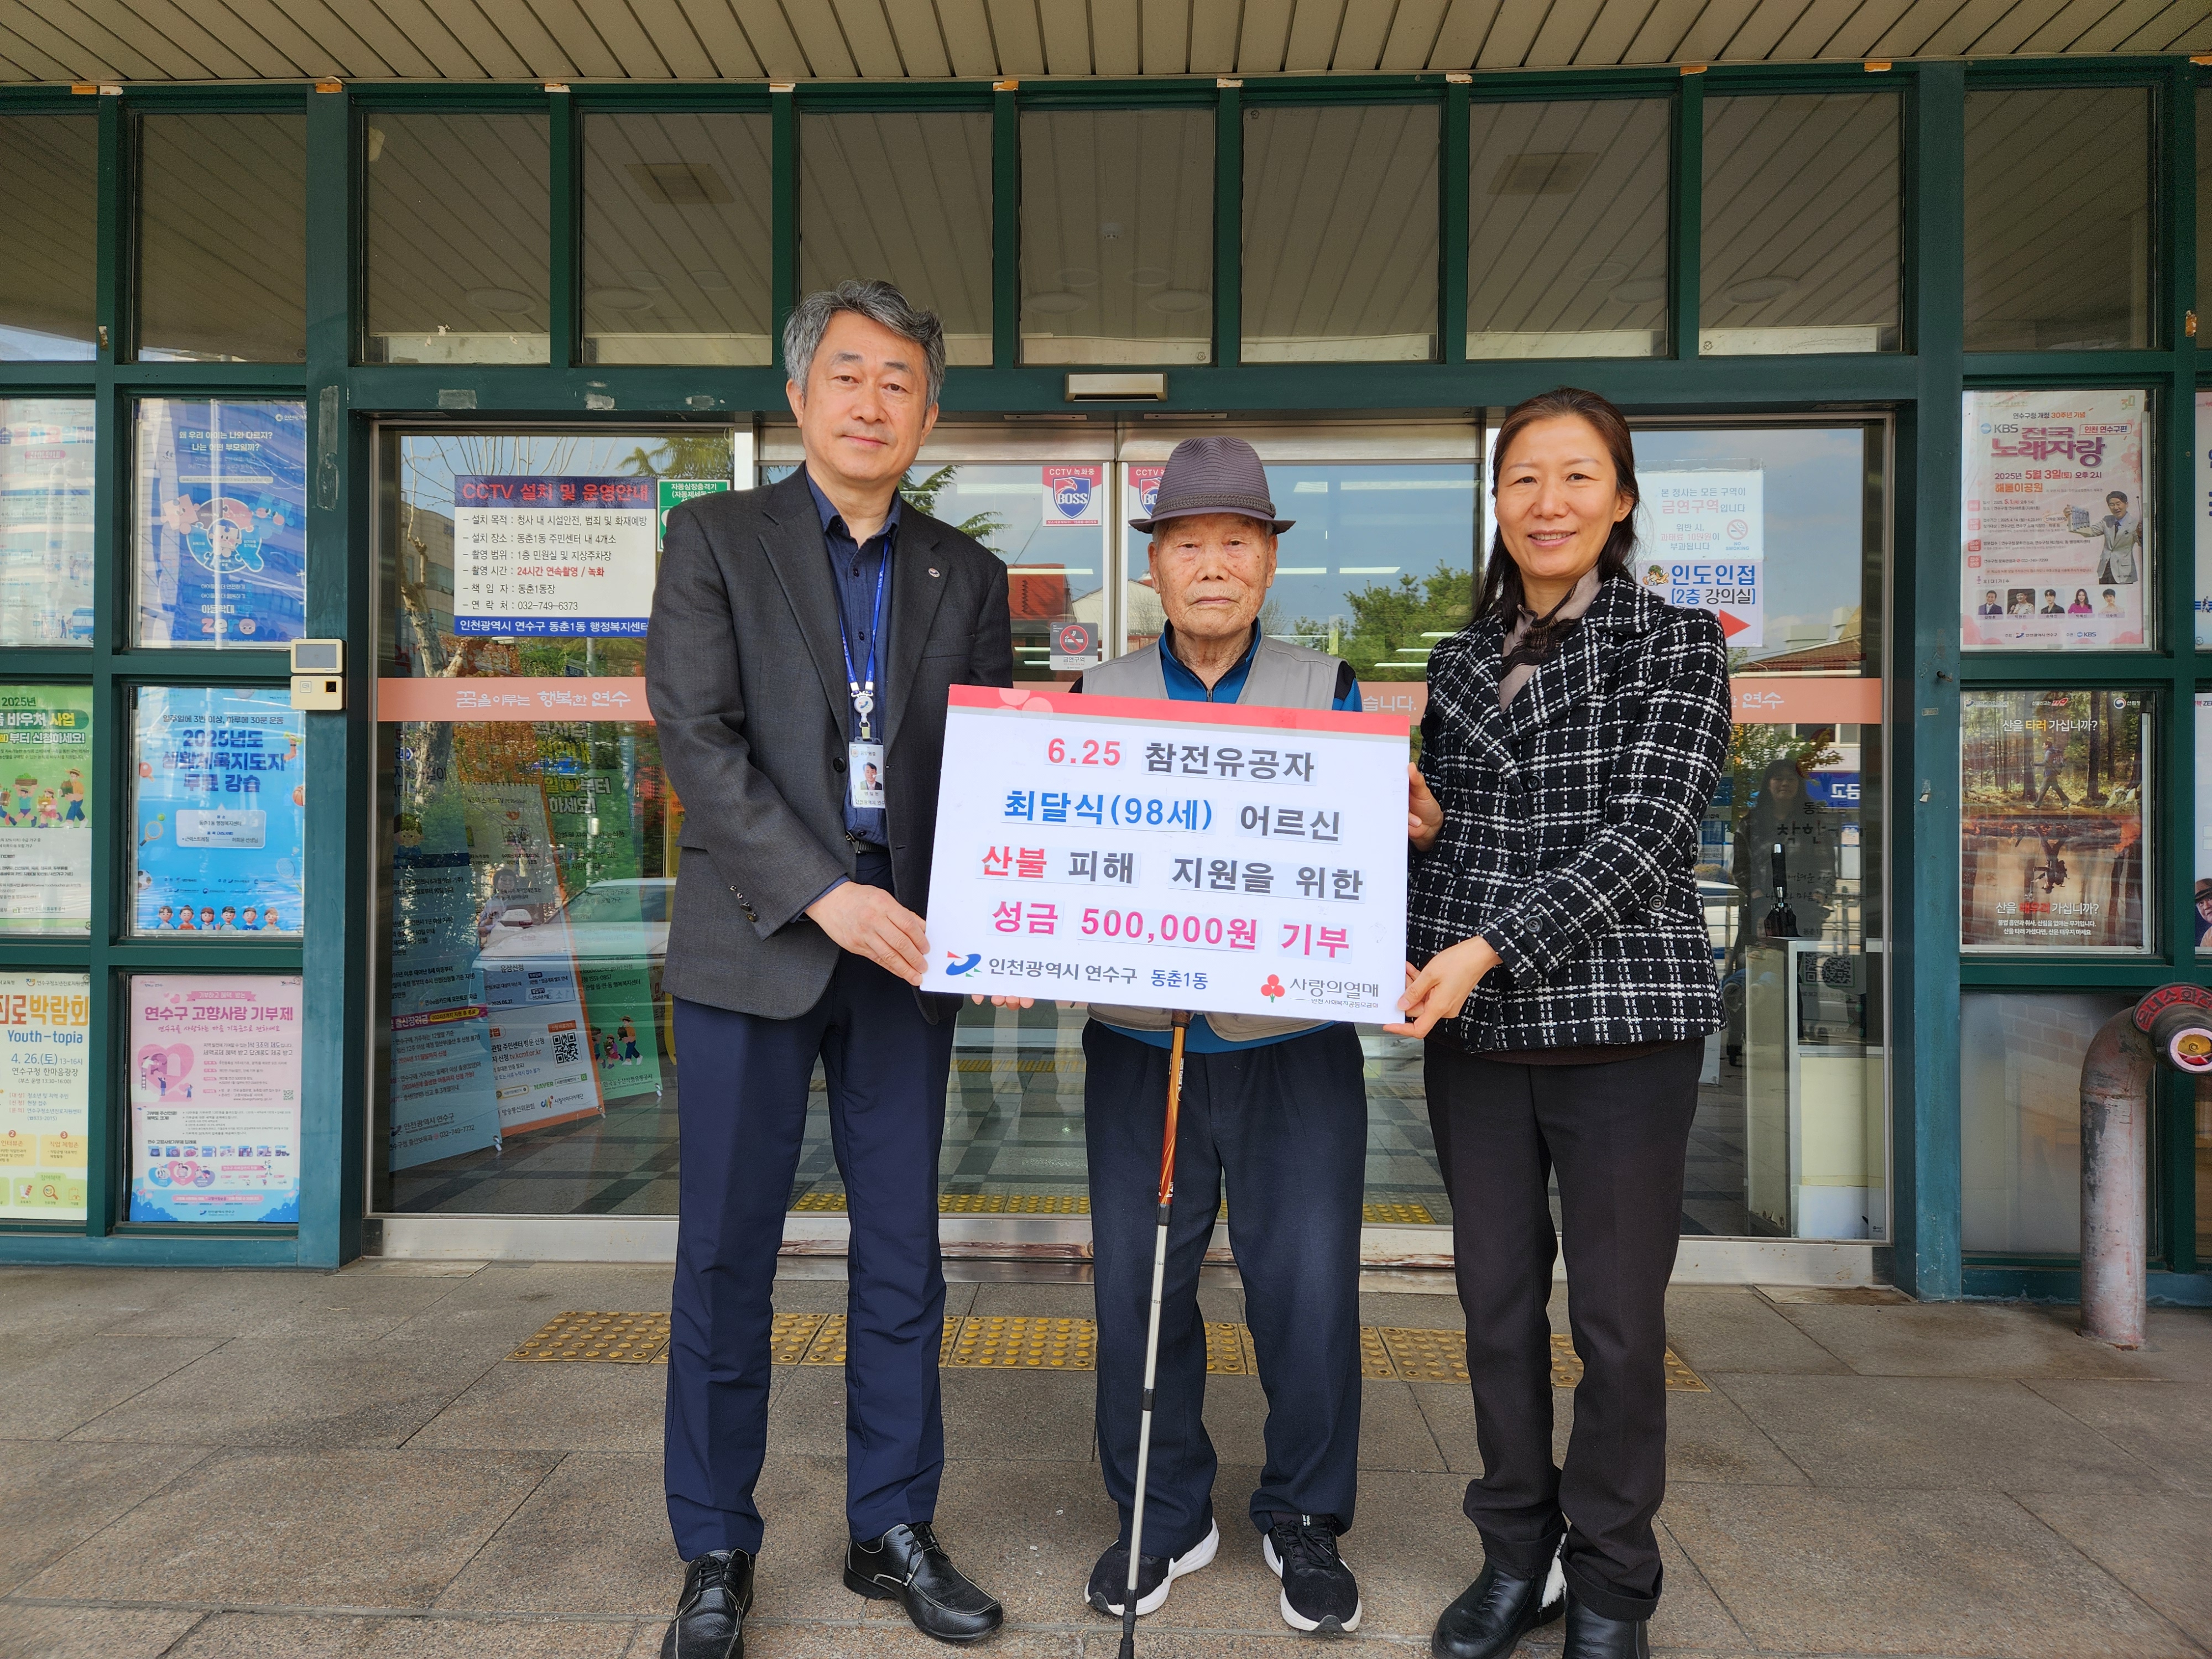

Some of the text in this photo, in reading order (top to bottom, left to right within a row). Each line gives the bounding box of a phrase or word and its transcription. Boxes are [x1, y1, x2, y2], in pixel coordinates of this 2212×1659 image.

[1994, 424, 2018, 433] KBS
[2022, 427, 2074, 439] 전국
[1991, 437, 2105, 467] 노래자랑
[1074, 468, 1095, 476] 녹화중
[2025, 470, 2042, 479] 5월
[2044, 469, 2072, 479] 3일(토)
[462, 483, 648, 502] CCTV 설치 및 운영안내
[1672, 488, 1697, 497] 청사는
[1701, 488, 1717, 497] 모든
[1721, 487, 1745, 496] 구역이
[1056, 493, 1088, 504] BOSS
[472, 515, 647, 526] 설치 목적 청사 내 시설안전, 범죄 및 화재예방
[472, 533, 616, 544] 설치 장소 동춘1동 주민센터 내 4개소
[472, 550, 612, 561] 촬영 범위 1층 민원실 및 지상주차장
[472, 566, 604, 577] 촬영 시간 24시간 연속촬영 녹화
[1672, 565, 1755, 585] 인도인접
[518, 585, 555, 594] 동춘1동장
[201, 605, 234, 613] 아동학대
[518, 601, 578, 611] 032-749-6373
[460, 620, 586, 632] 인천광역시 연수구 동춘1동
[2, 697, 36, 707] 2025년
[537, 690, 587, 707] 행복한
[592, 691, 631, 707] 연수
[1743, 692, 1785, 709] 연수
[2051, 698, 2068, 706] 119
[7, 712, 75, 726] 바우처 사업
[163, 714, 192, 723] 일주일에
[209, 716, 225, 724] 이상,
[2002, 719, 2098, 732] 산을 타러 가십니까?
[10, 733, 85, 743] 부터 신청하세요!
[183, 729, 263, 748] 2025년도
[163, 752, 284, 771] 생활체육지도자
[1047, 738, 1314, 782] 6.25 참전유공자
[184, 774, 260, 792] 무료 강습
[1004, 790, 1340, 842] 최달식(98세) 어르신
[982, 846, 1363, 900] 산불 피해 지원을 위한
[1996, 902, 2017, 914] 산을
[2052, 902, 2099, 915] 가십니까?
[993, 901, 1350, 958] 성금 500,000원 기부
[500, 964, 524, 973] 유상신청
[989, 958, 1208, 990] 인천광역시 연수구 동춘1동
[1290, 977, 1380, 1000] 사랑의열매
[145, 1006, 293, 1020] 연수구 고향사랑 기부제
[158, 1025, 181, 1034] 연수구를
[24, 1053, 58, 1065] 26.(토)
[534, 1082, 553, 1090] NAVER
